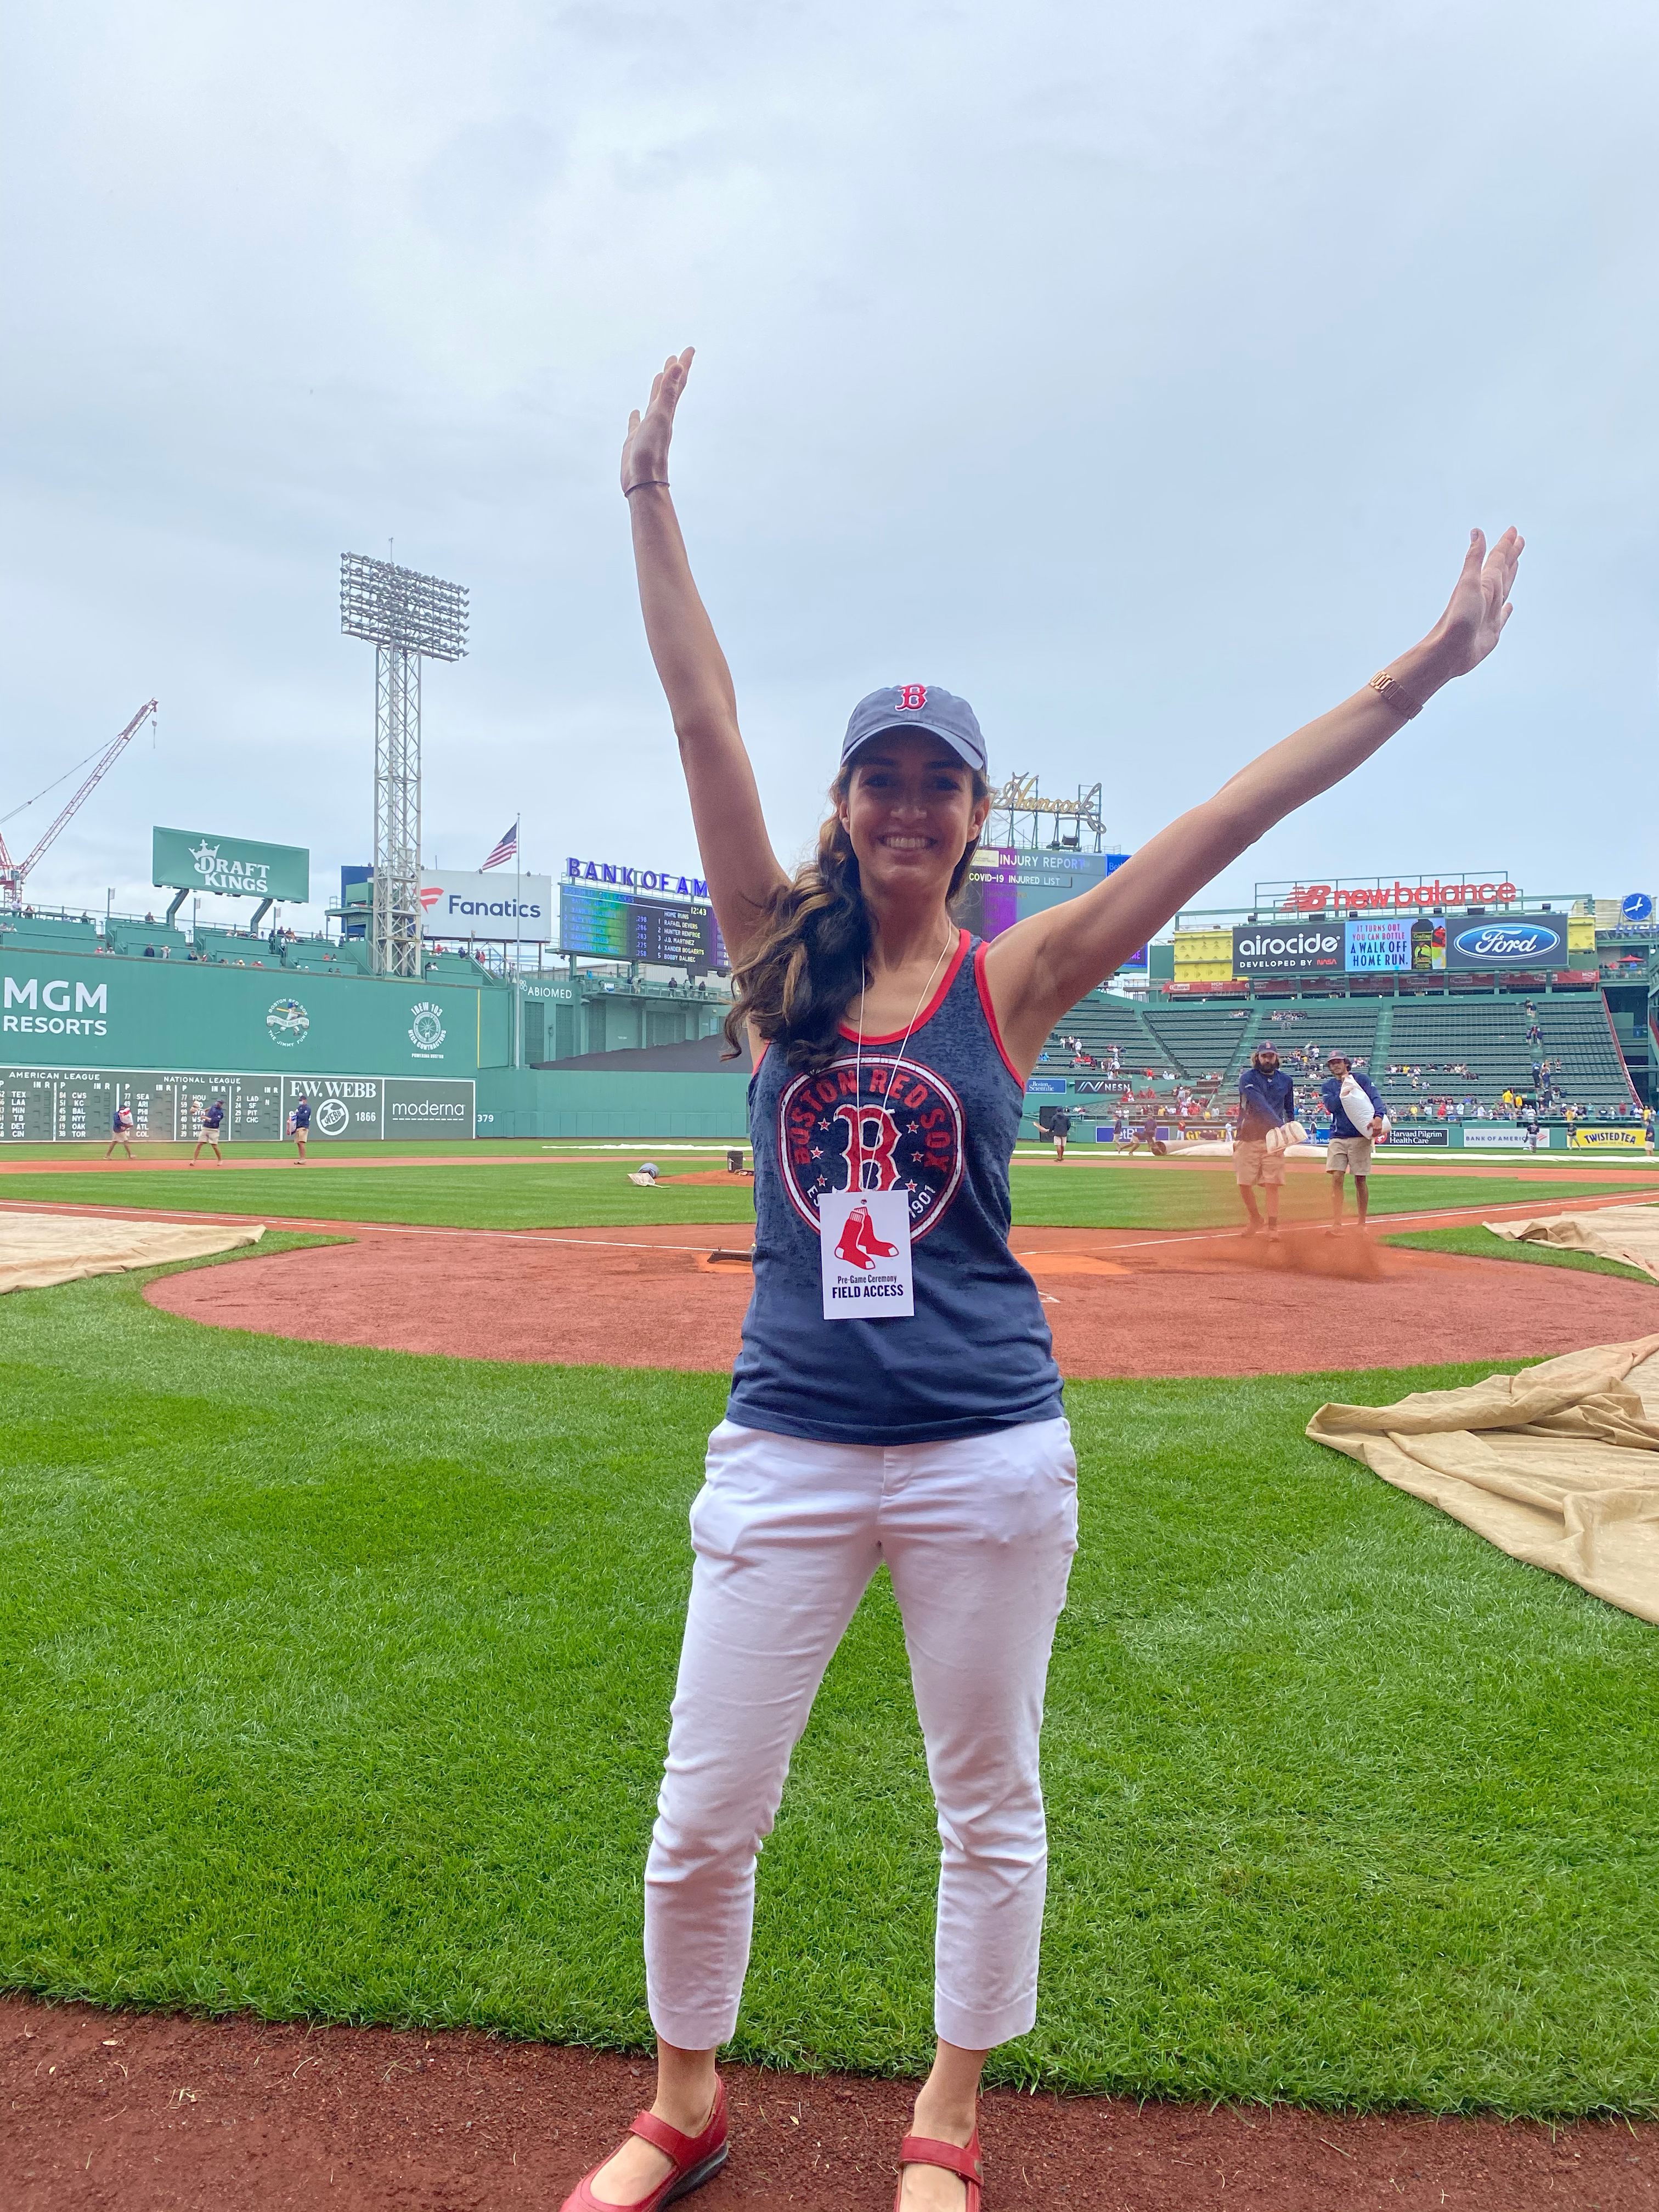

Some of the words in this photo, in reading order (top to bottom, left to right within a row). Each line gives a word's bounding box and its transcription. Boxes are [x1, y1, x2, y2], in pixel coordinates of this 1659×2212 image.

[895, 683, 928, 712] B
[991, 771, 1107, 834] Hancock
[194, 855, 270, 878] DRAFT
[1000, 854, 1039, 867] INJURY
[1043, 856, 1085, 870] REPORT
[205, 872, 269, 893] KINGS
[566, 857, 635, 887] BANK
[641, 870, 670, 891] OF
[675, 876, 709, 898] AM
[969, 873, 1005, 883] COVID-19
[1008, 874, 1040, 885] INJURED
[1043, 877, 1060, 886] LIST
[449, 895, 541, 918] Fanatics
[691, 907, 707, 916] 12:43
[1239, 933, 1338, 956] airocide
[1351, 943, 1356, 953] A
[1359, 942, 1385, 953] WALK
[1389, 941, 1407, 952] OFF
[1476, 929, 1538, 953] Ford
[664, 945, 681, 953] XANDER
[682, 947, 704, 955] BOGAERTS
[1353, 955, 1381, 966] HOME
[1385, 954, 1408, 965] RUN.
[4, 977, 107, 1014] MGM
[528, 986, 572, 998] ABIOMED
[268, 998, 286, 1013] BOSTON
[300, 1005, 308, 1015] SOX
[410, 1002, 428, 1015] IBEW
[431, 1003, 443, 1017] 103
[3, 1015, 107, 1036] RESORTS
[268, 1030, 276, 1041] THE
[297, 1031, 308, 1044] FUND
[416, 1030, 447, 1050] CONTRACTORS
[290, 1080, 323, 1097] F.W.
[326, 1082, 376, 1098] WEBB
[355, 1111, 376, 1121] 1866
[392, 1100, 464, 1116] moderna
[324, 1110, 342, 1124] WEBB
[477, 1114, 494, 1122] 379
[791, 1070, 857, 1165] BOSTON
[869, 1069, 928, 1109] RED
[921, 1108, 951, 1173] SOX
[1584, 1132, 1620, 1144] TWISTED
[1621, 1132, 1636, 1144] TEA
[833, 1104, 902, 1193] B
[909, 1184, 936, 1218] 1901
[838, 1276, 866, 1284] Pre-Game
[868, 1274, 897, 1283] Ceremony
[832, 1286, 861, 1298] FIELD
[864, 1284, 904, 1297] ACCESS
